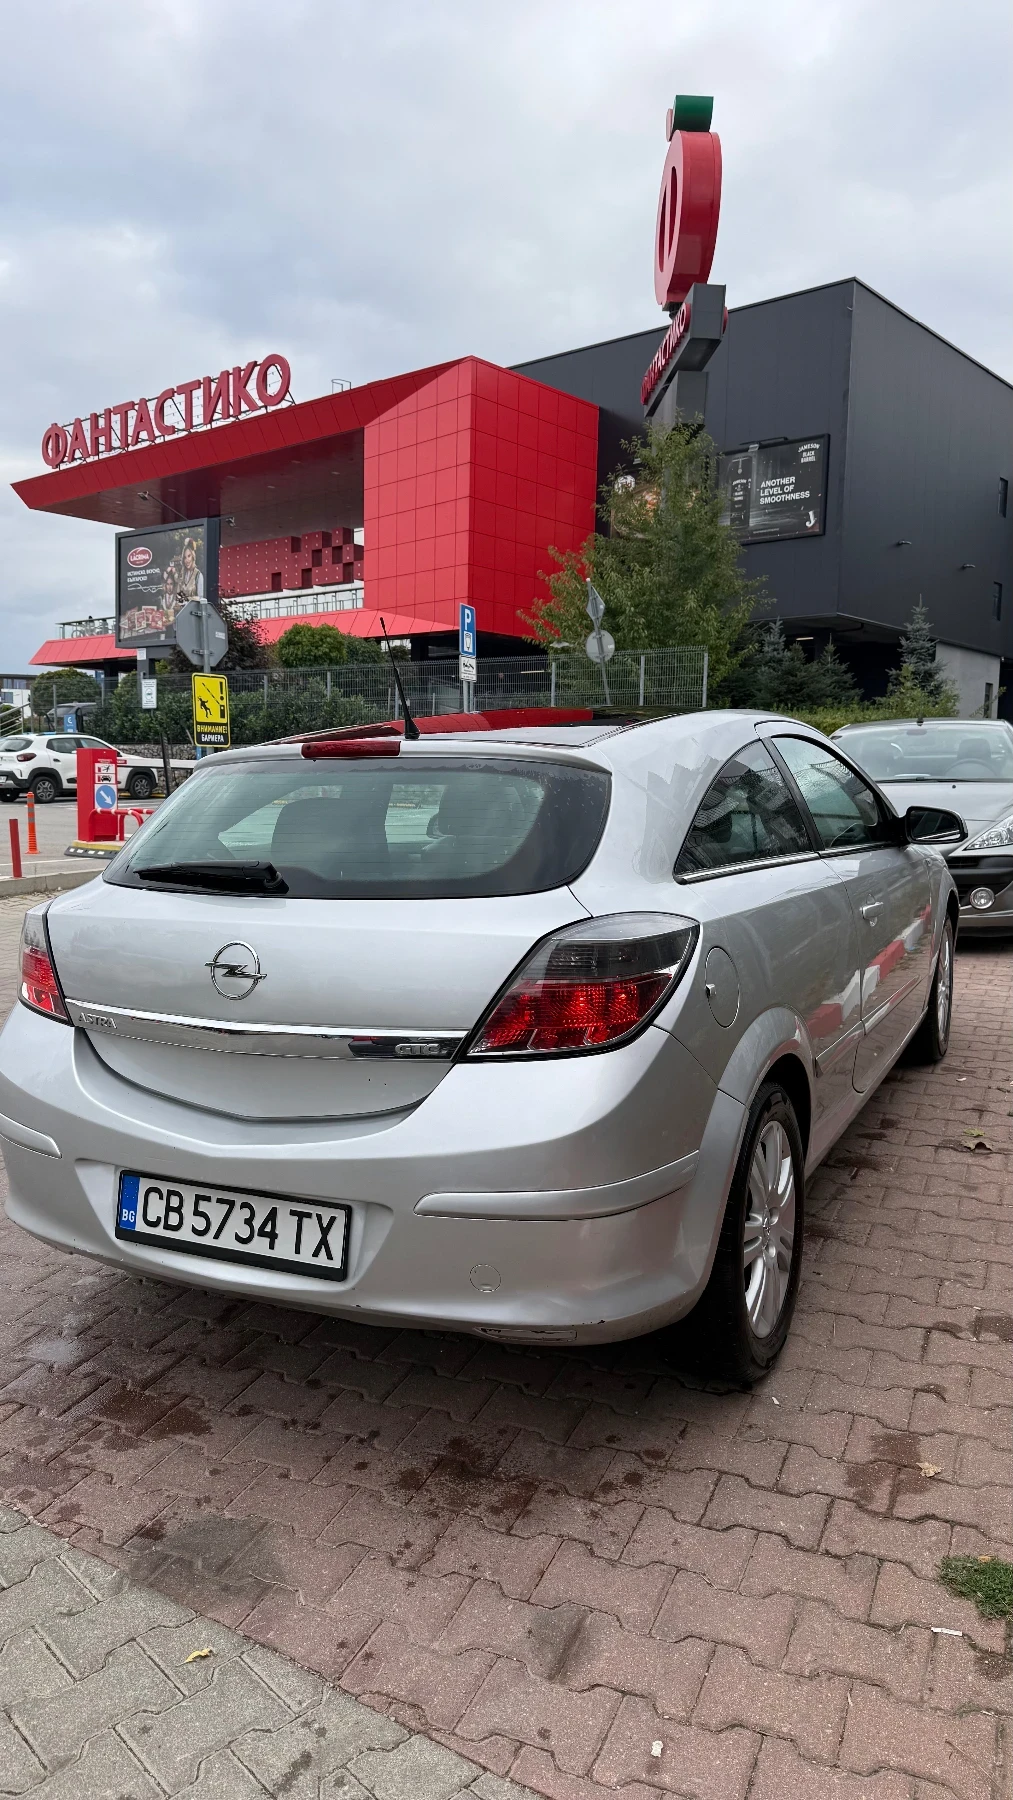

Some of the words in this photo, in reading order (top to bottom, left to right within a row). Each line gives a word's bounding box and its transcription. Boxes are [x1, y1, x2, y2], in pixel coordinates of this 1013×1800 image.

[42, 354, 291, 469] ФАНТАСТИКО
[798, 443, 820, 453] JAMESON
[760, 476, 796, 488] ANOTHER
[760, 486, 782, 496] LEVEL
[784, 485, 795, 493] OF
[760, 491, 810, 505] SMOOTHNESS
[464, 608, 472, 631] P
[197, 724, 228, 734] ВНИМАНИЕ!
[201, 733, 225, 743] БАРИЕРА
[79, 1012, 118, 1029] ASTRA
[394, 1043, 440, 1055] GTC
[122, 1208, 136, 1223] BG
[142, 1186, 184, 1232] CB
[191, 1193, 279, 1250] 5734
[289, 1208, 338, 1261] TX
